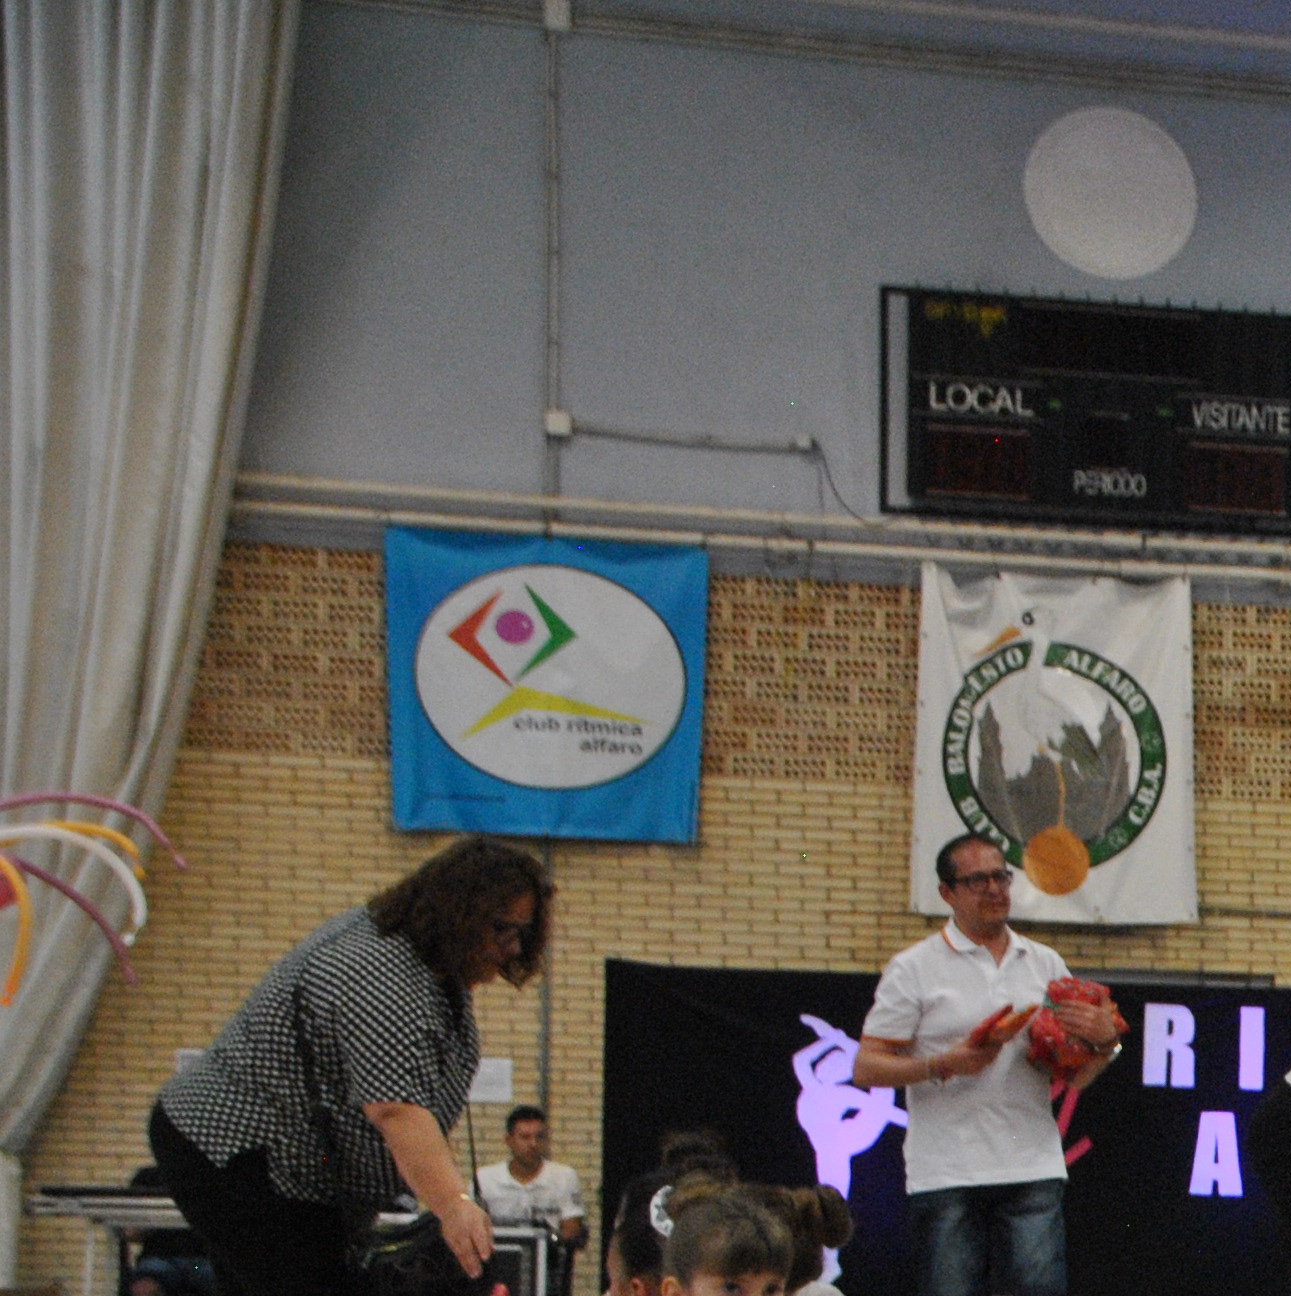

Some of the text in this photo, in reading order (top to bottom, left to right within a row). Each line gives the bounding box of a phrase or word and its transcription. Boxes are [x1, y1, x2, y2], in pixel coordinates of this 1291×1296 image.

[929, 380, 1035, 416] LOCAL
[1192, 401, 1291, 435] VISITANTE
[1063, 648, 1148, 715] ALFARO
[512, 716, 561, 733] club
[580, 738, 643, 755] alfaro
